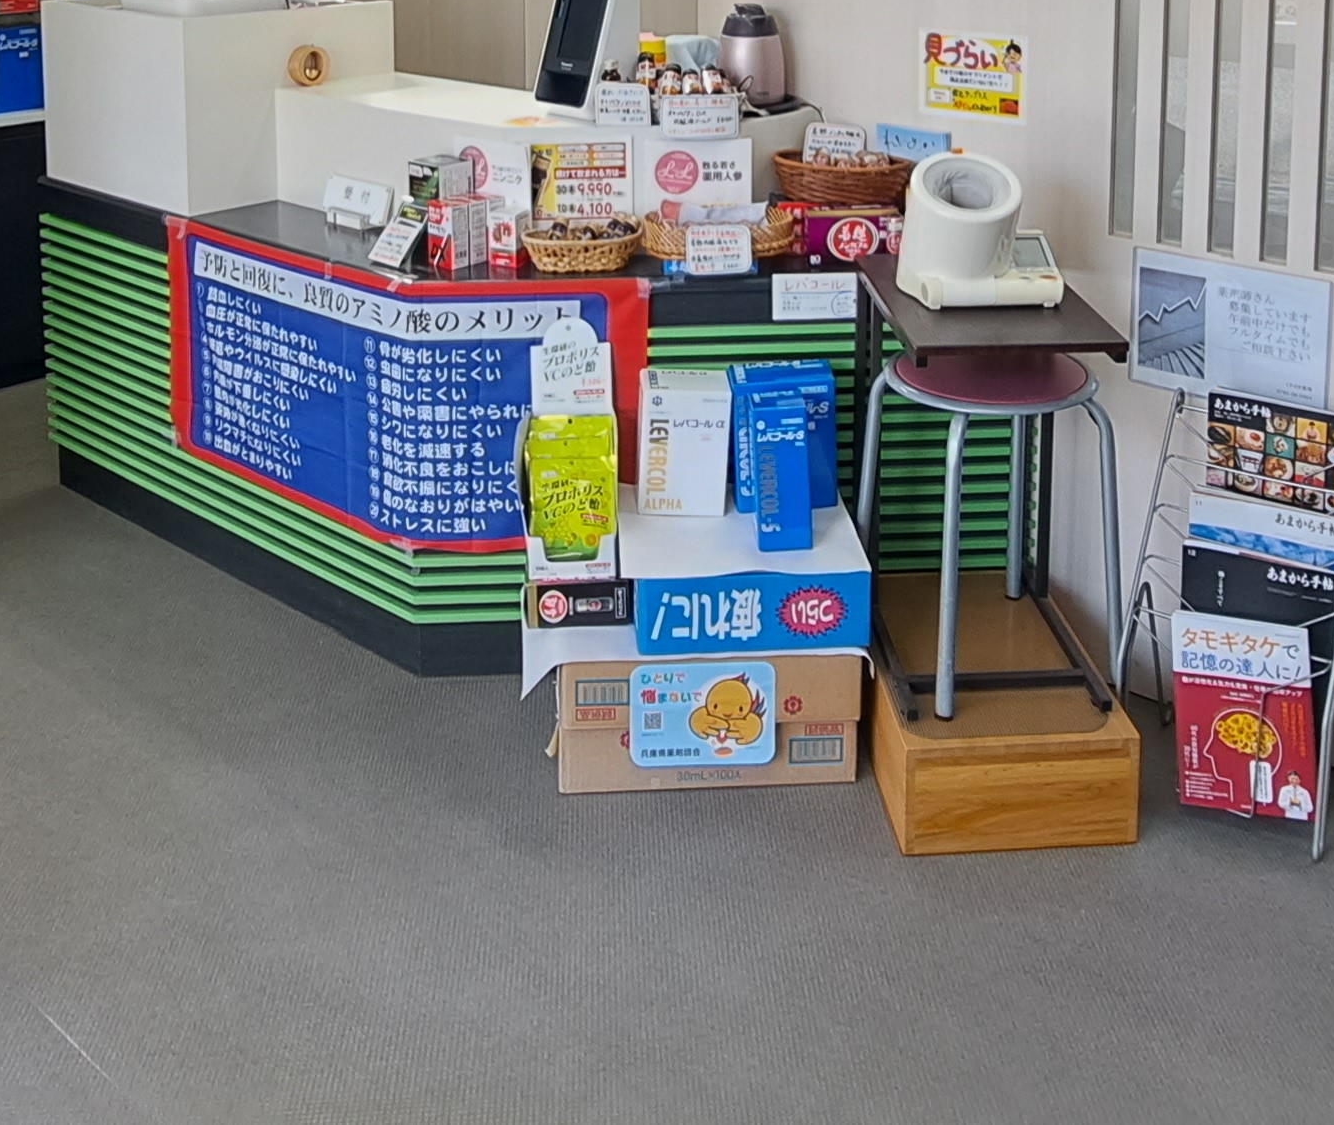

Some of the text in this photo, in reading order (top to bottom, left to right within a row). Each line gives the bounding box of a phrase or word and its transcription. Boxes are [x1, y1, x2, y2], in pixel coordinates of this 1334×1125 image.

[491, 172, 523, 186] ニンニク
[343, 186, 373, 205] 受付
[576, 202, 613, 216] 4,100
[784, 278, 846, 291] レバコール
[1218, 286, 1276, 305] 薬剤師さん
[1229, 301, 1312, 323] 募集しています
[205, 304, 318, 351] 血圧が正常に保たれやすい
[1228, 313, 1311, 338] 午前中だけでも
[1229, 327, 1311, 351] フルタイムでも
[1241, 340, 1311, 362] ご相談下さい
[206, 322, 357, 383] ホルモン分泌が正常に保たれやすい
[379, 340, 501, 365] 骨が劣化しにくい
[543, 346, 600, 369] プロポリス
[380, 360, 502, 381] 虫歯になりにくい
[543, 360, 597, 383] VCのど飴
[380, 378, 467, 402] 疲労しにくい
[1213, 397, 1272, 418] あまから手帖
[381, 416, 502, 440] シワになりにくい
[214, 418, 302, 467] リウマチになりにくい
[381, 434, 485, 459] 老化を減速する
[645, 418, 670, 497] LEVERCOL
[543, 482, 604, 507] プロポリス
[643, 498, 683, 511] ALPHA
[543, 497, 600, 521] VCのど飴
[380, 510, 486, 534] ストレスに強い
[1266, 566, 1334, 591] あまから手帖
[791, 597, 835, 625] つらい
[1181, 627, 1300, 660] タモギタケで
[1181, 650, 1302, 682] 記憶の達人に!
[640, 672, 686, 686] ひとりで
[640, 689, 703, 705] 悩まないで
[640, 748, 701, 759] 兵庫県薬剤師会
